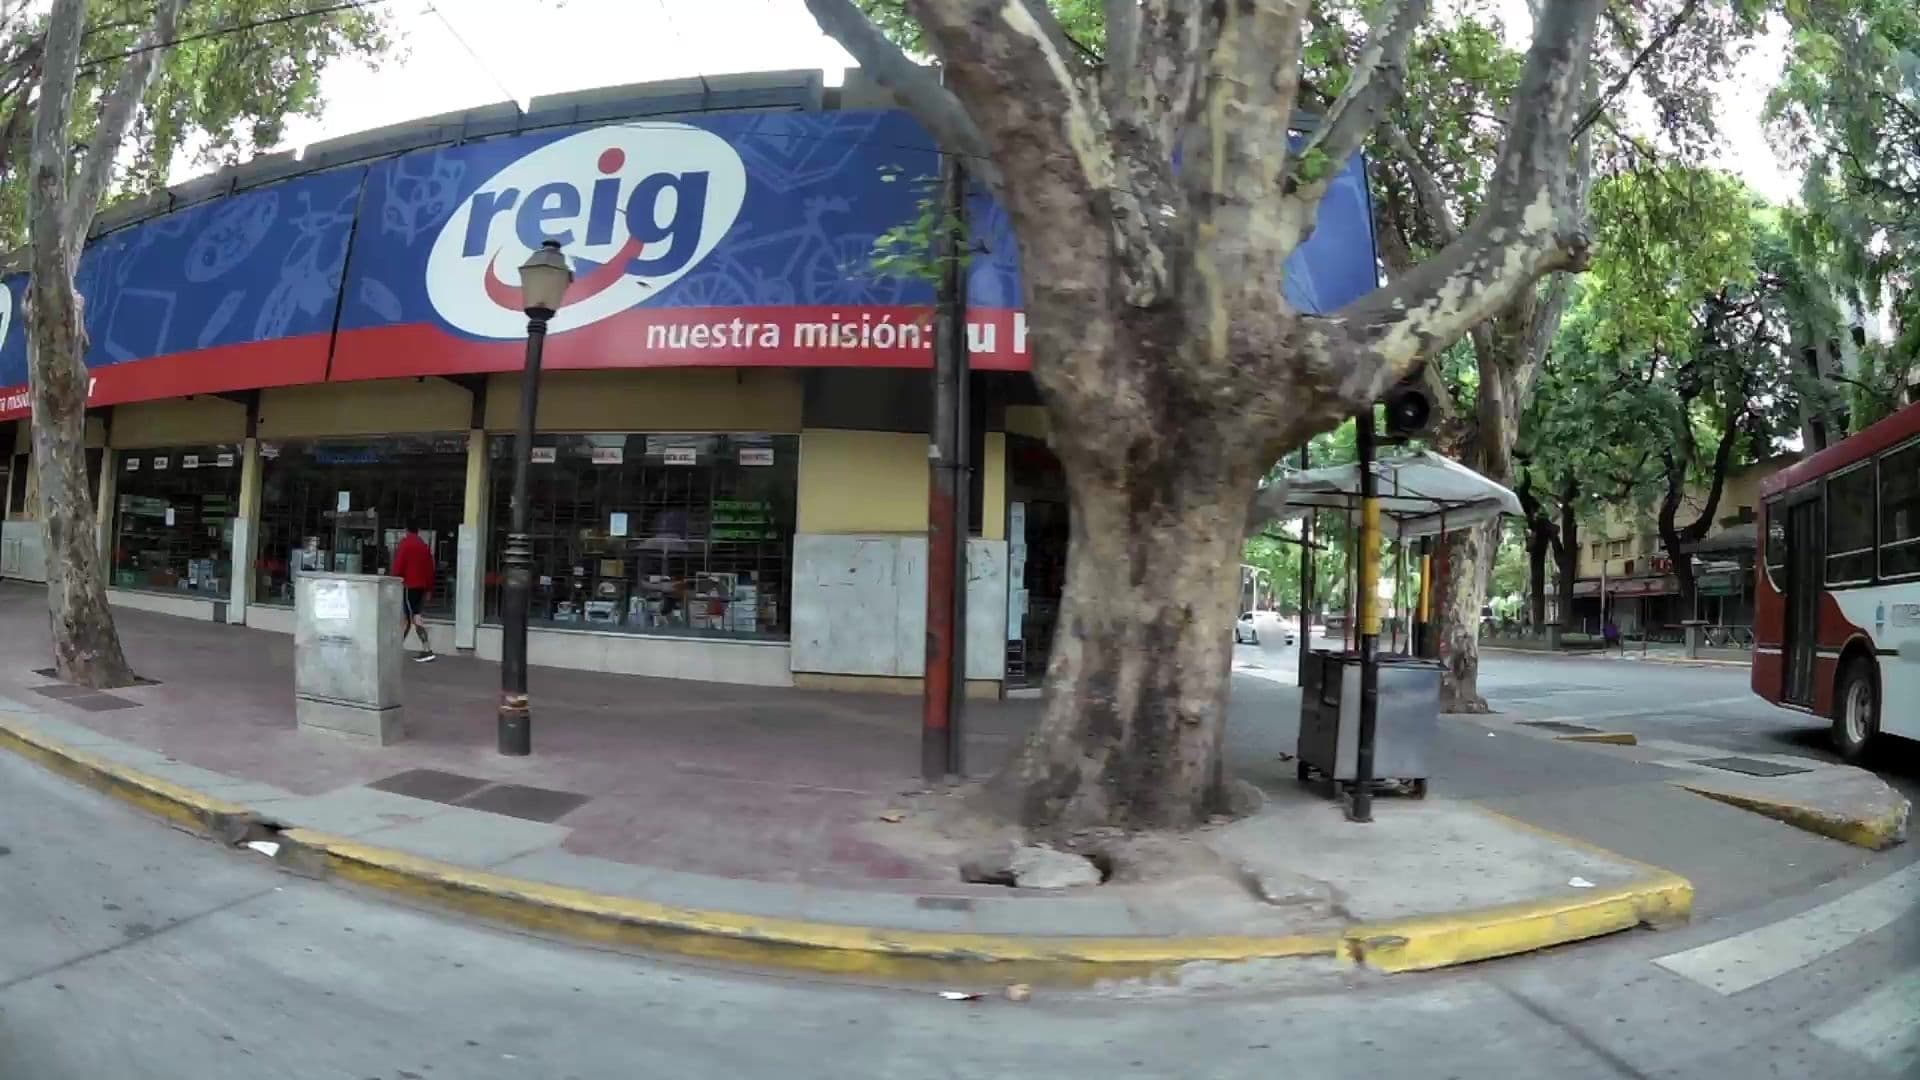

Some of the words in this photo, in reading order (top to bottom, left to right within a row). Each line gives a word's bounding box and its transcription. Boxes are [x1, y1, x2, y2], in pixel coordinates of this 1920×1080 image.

[462, 147, 710, 278] reig
[646, 317, 781, 350] nuestra
[793, 313, 932, 350] misión:
